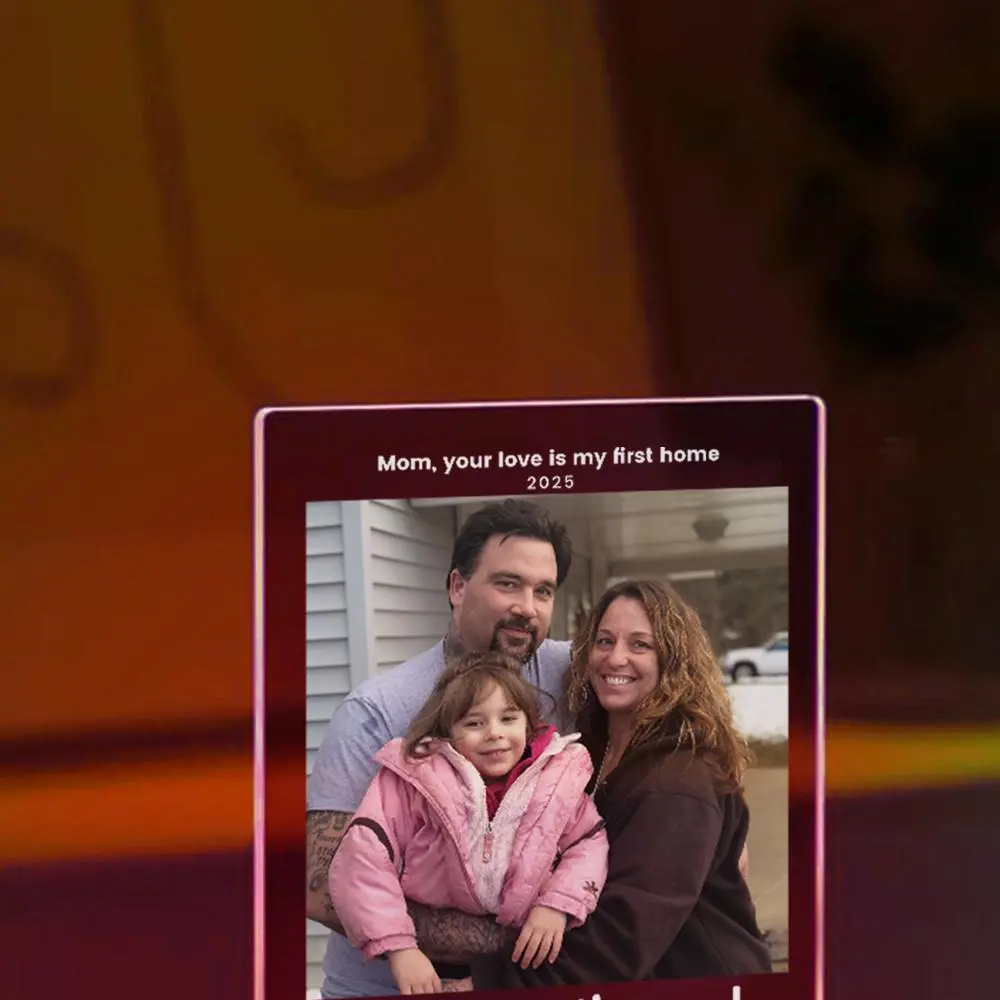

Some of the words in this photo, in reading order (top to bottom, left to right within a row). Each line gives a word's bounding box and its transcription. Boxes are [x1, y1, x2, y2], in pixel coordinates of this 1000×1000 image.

[377, 454, 438, 473] Mom,
[442, 454, 493, 475] your
[498, 449, 543, 468] love
[549, 448, 567, 467] is
[573, 450, 607, 471] my
[613, 446, 653, 465] first
[659, 446, 720, 463] home
[526, 474, 574, 490] 2025
